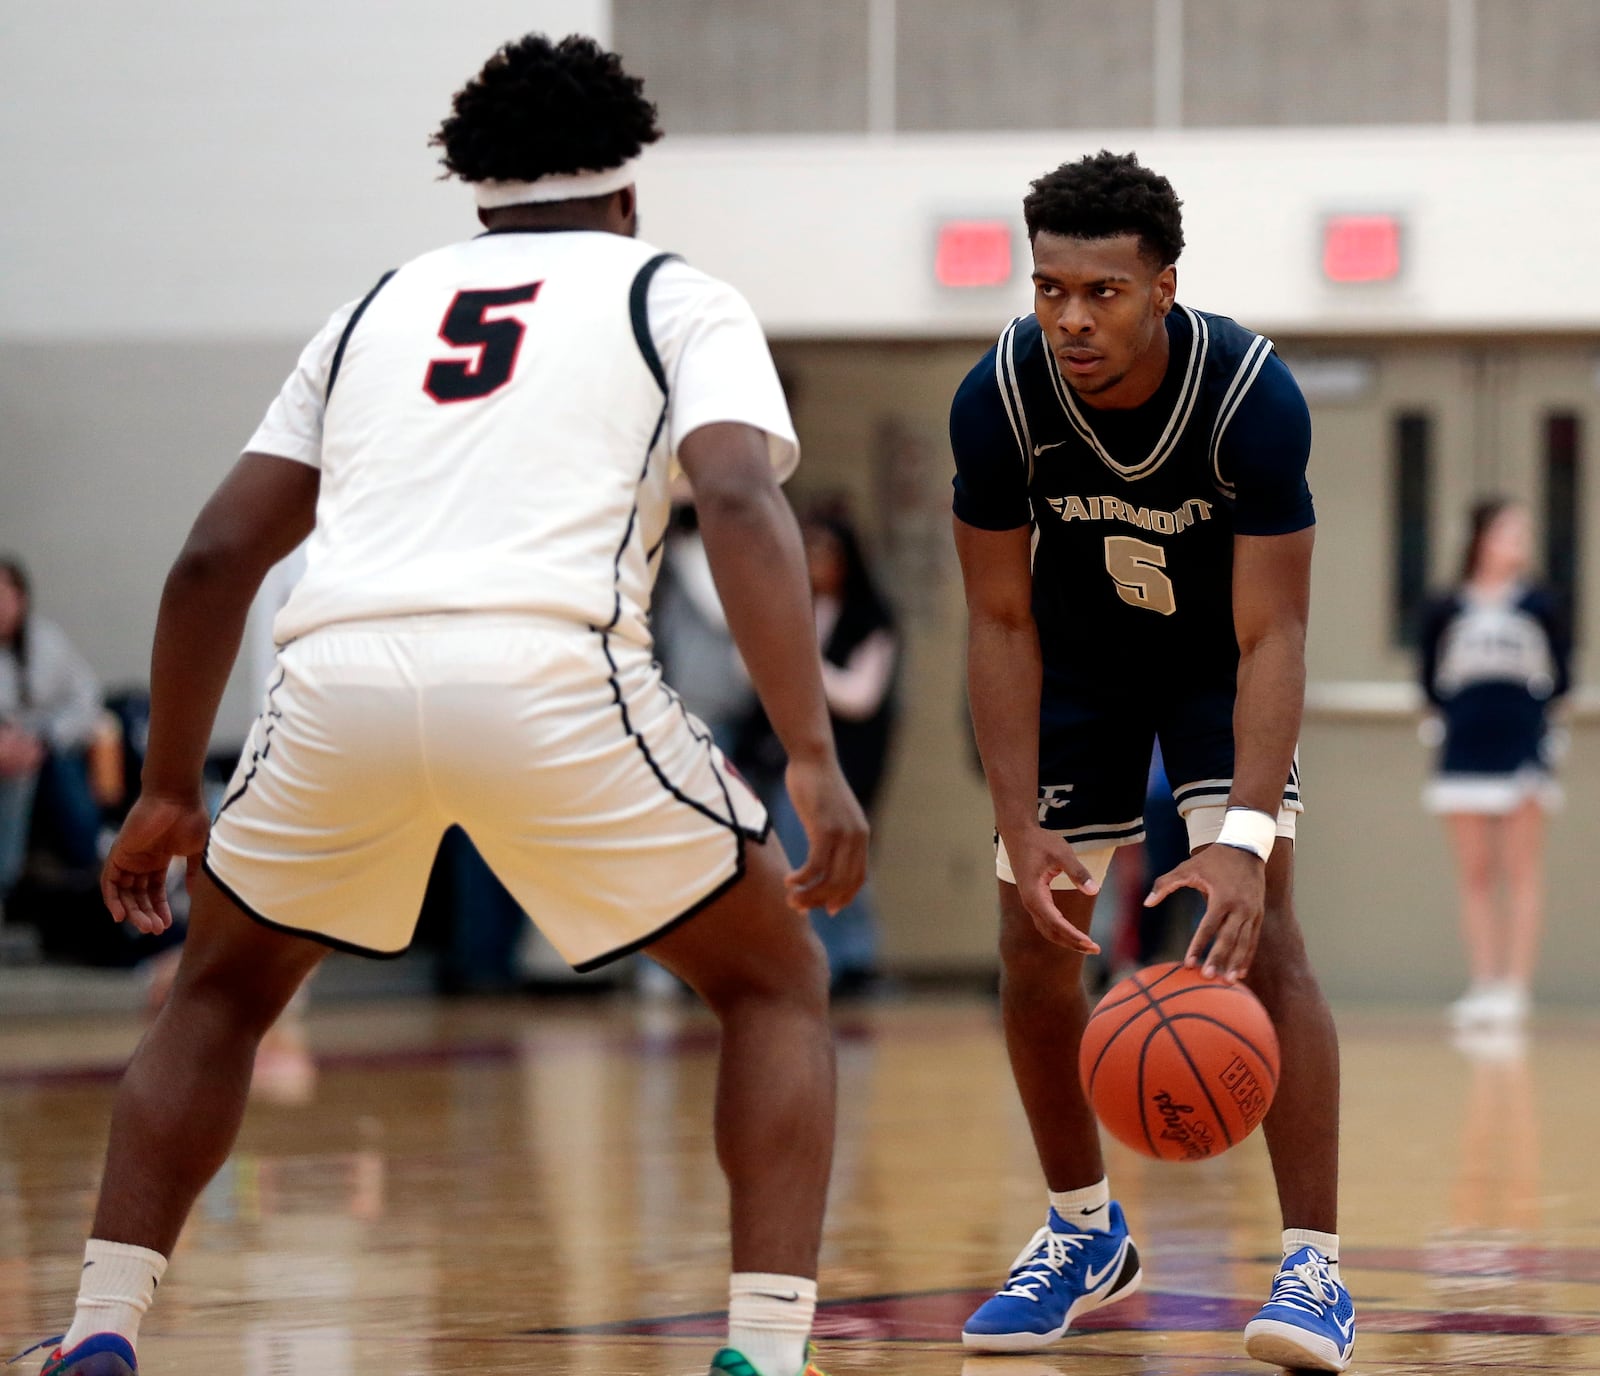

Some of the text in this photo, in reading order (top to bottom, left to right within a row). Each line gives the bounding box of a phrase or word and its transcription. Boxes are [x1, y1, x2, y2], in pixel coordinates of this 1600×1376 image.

[423, 278, 545, 405] 5
[1045, 496, 1213, 535] FAIRMONT
[1103, 535, 1177, 616] 5
